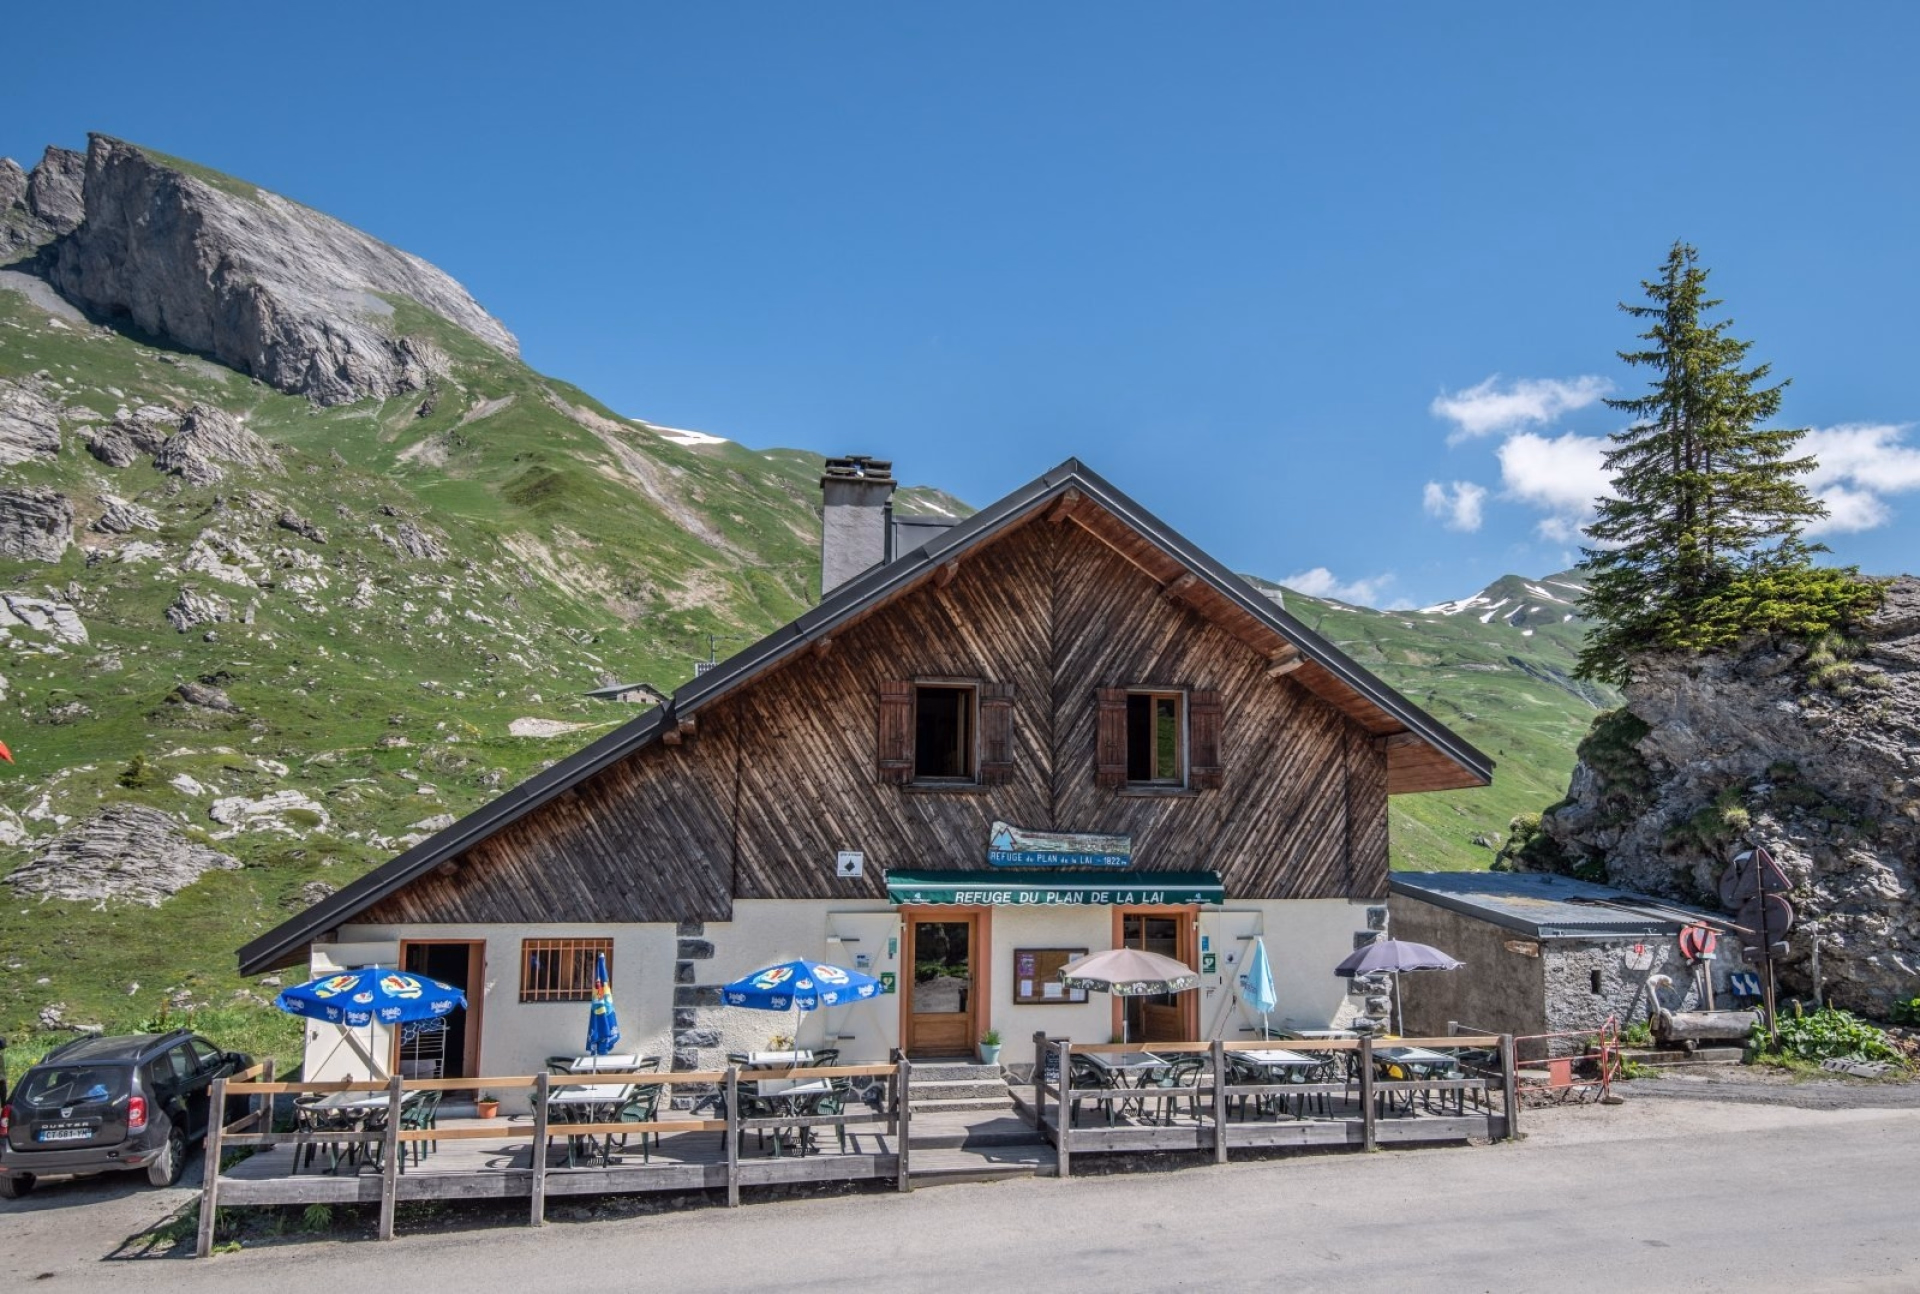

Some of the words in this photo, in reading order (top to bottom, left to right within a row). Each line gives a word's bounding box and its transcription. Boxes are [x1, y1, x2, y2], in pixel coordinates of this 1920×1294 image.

[990, 851, 1022, 862] REFUGE
[1037, 854, 1058, 864] PLAN
[1080, 856, 1092, 865] LAI
[1104, 856, 1120, 865] 1822
[955, 891, 1012, 904] REFUGE
[1019, 891, 1039, 904] DU
[1046, 891, 1083, 904] PLAN
[1091, 891, 1110, 904] DE
[1116, 891, 1134, 904] LA
[1142, 891, 1164, 904] LAI
[41, 1121, 89, 1129] DUSTER
